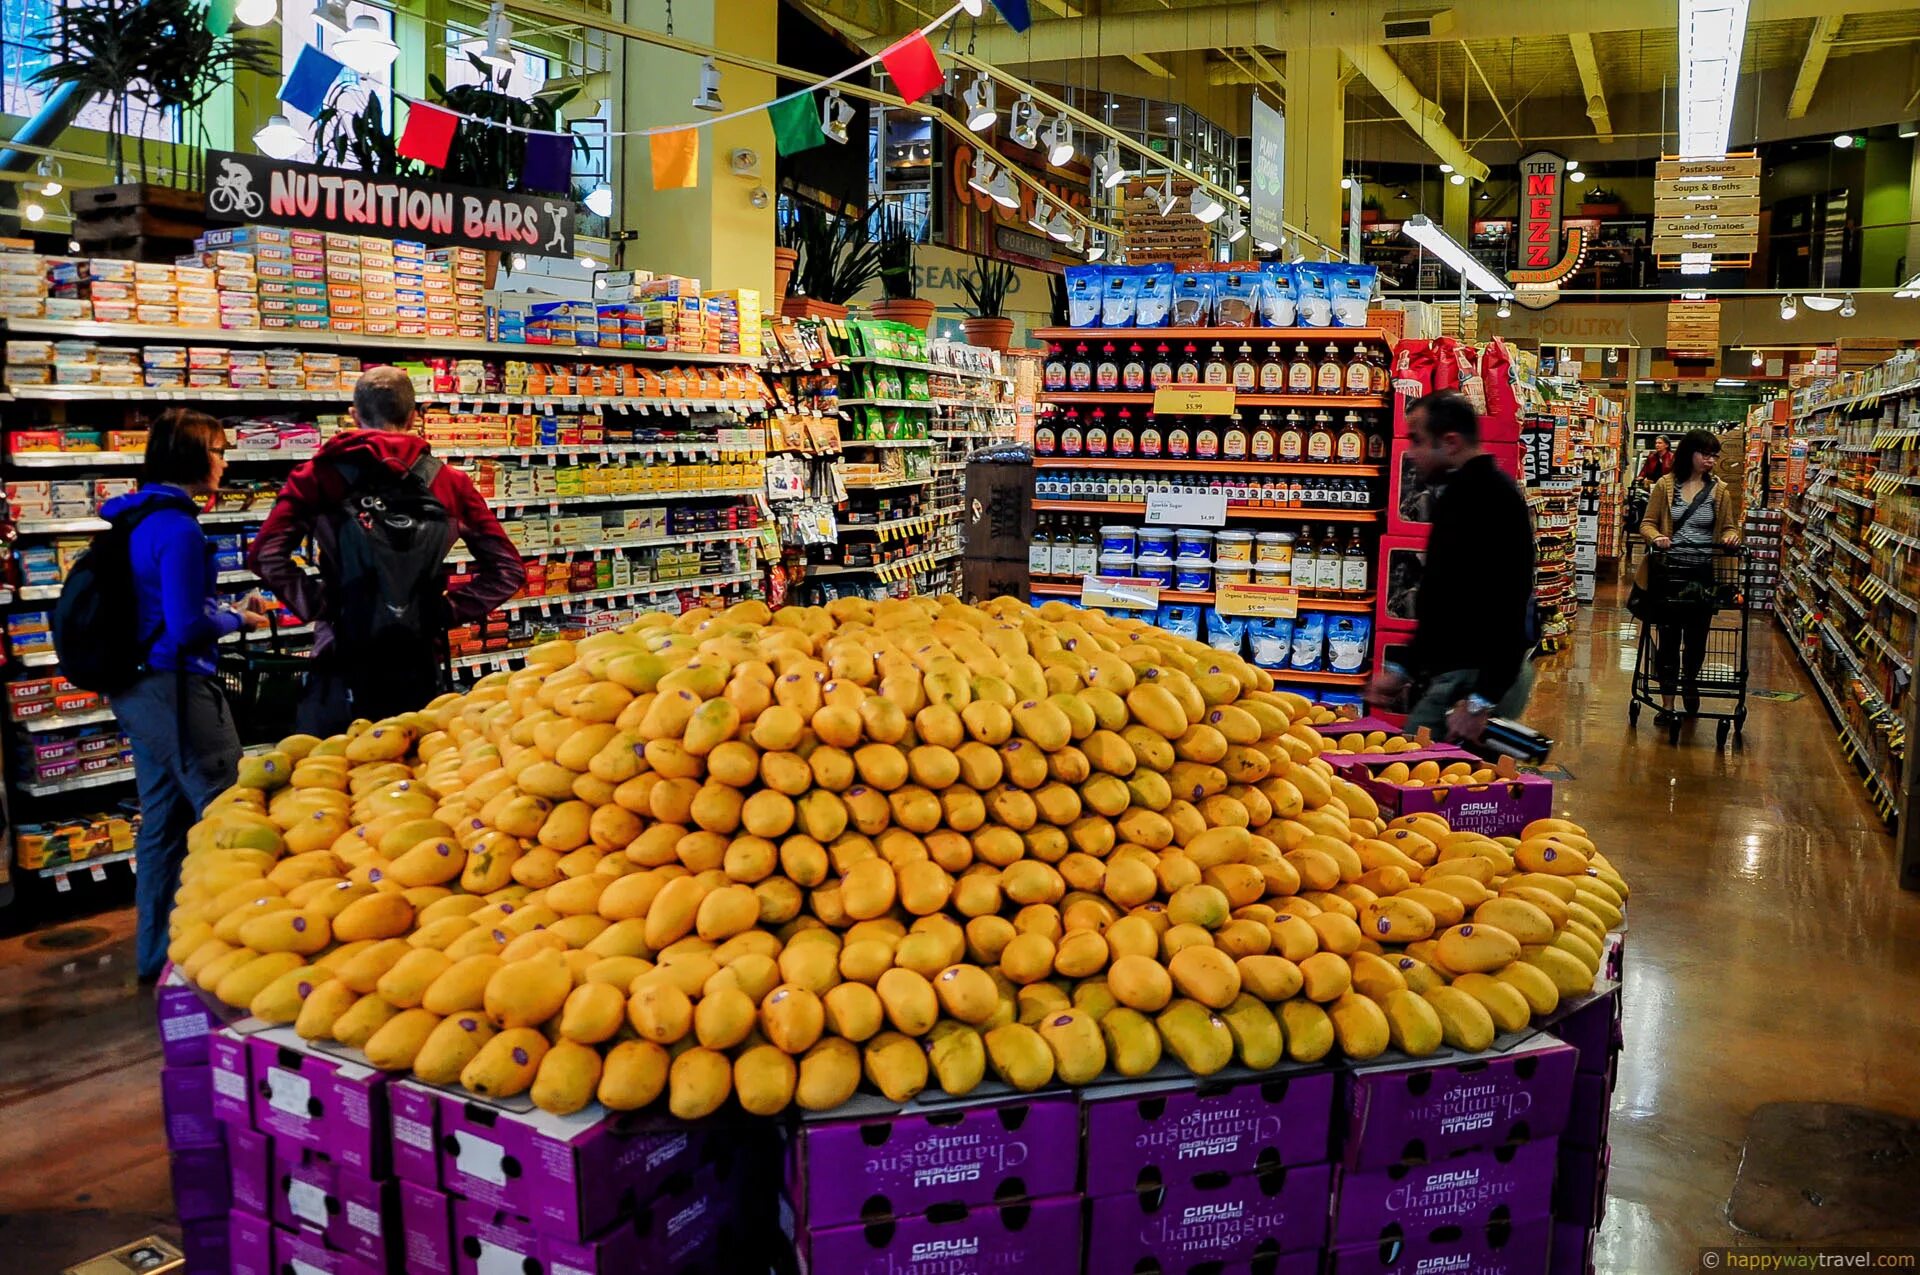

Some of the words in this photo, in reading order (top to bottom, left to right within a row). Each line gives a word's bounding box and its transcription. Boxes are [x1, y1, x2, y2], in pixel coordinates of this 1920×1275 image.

[1527, 162, 1556, 174] THE
[1680, 165, 1703, 173] Pasta
[1673, 184, 1699, 193] Soups
[1701, 183, 1709, 191] &
[1712, 182, 1741, 191] Broths
[270, 169, 453, 234] NUTRITION
[463, 196, 540, 245] BARS
[1695, 203, 1718, 211] Pasta
[1152, 218, 1183, 227] Packaged
[1527, 174, 1556, 267] MEZZ
[1667, 223, 1700, 231] Canned
[1703, 222, 1745, 231] Tomatoes
[211, 231, 232, 245] CLIF
[1003, 233, 1046, 256] PORTLAND
[1130, 236, 1146, 244] Bulk
[1178, 235, 1201, 243] Grains
[1692, 241, 1718, 249] Beans
[1130, 252, 1146, 260] Bulk
[1147, 252, 1171, 261] Baking
[1173, 252, 1202, 260] Supplies
[1528, 317, 1626, 336] POULTRY
[1461, 802, 1498, 811] CIRULI
[1443, 1084, 1497, 1101] mango
[1180, 1108, 1240, 1126] mango
[1441, 1110, 1496, 1125] BROTHERS
[1135, 1116, 1282, 1148] Champagne
[1440, 1117, 1494, 1135] CIRULI
[915, 1134, 981, 1152] mango
[1179, 1134, 1240, 1150] BROTHERS
[865, 1141, 1028, 1174] Champagne
[1178, 1142, 1238, 1160] CIRULI
[914, 1169, 980, 1187] CIRULI
[915, 1162, 983, 1177] BROTHERS
[1427, 1168, 1481, 1185] CIRULI
[1424, 1176, 1479, 1192] BROTHERS
[1385, 1179, 1516, 1212] Champagne
[1184, 1200, 1244, 1218] CIRULI
[1424, 1199, 1477, 1217] mango
[1182, 1210, 1244, 1225] BROTHERS
[1140, 1212, 1285, 1246] Champagne
[912, 1236, 979, 1254] CIRULI
[1183, 1233, 1242, 1252] mango
[911, 1247, 978, 1262] BROTHERS
[1417, 1253, 1470, 1269] CIRULI
